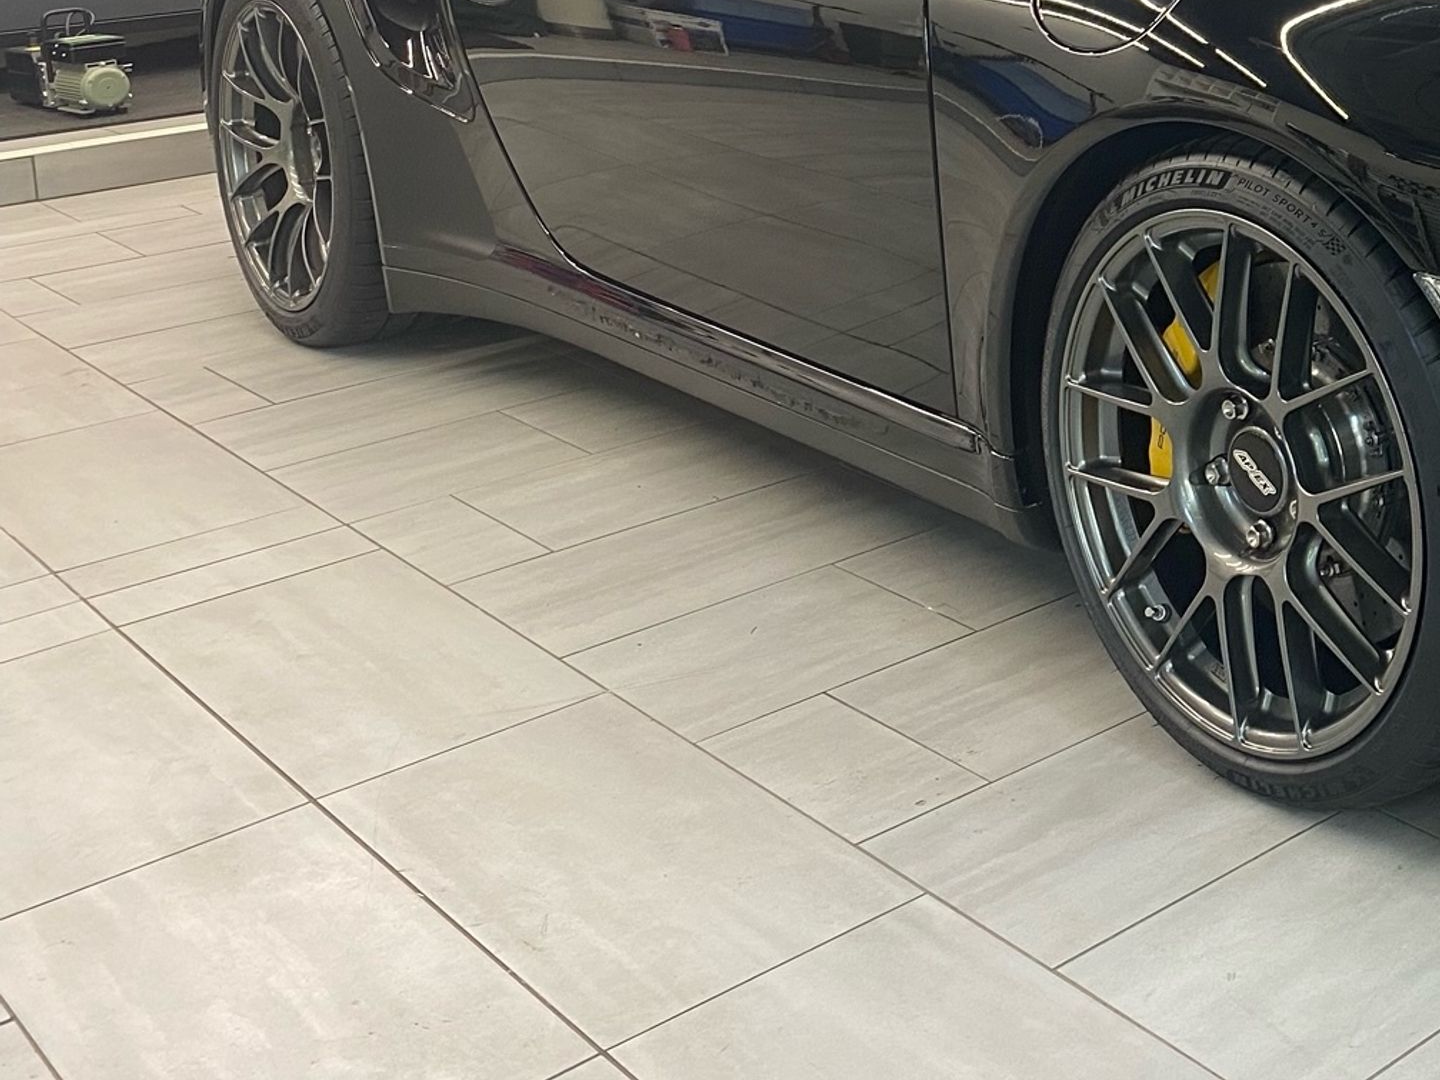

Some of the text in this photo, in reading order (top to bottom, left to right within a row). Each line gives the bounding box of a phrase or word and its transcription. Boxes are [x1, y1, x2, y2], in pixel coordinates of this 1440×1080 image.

[1121, 169, 1225, 208] MICHELIN
[1237, 178, 1271, 197] PILOT
[1272, 193, 1312, 224] SPORT
